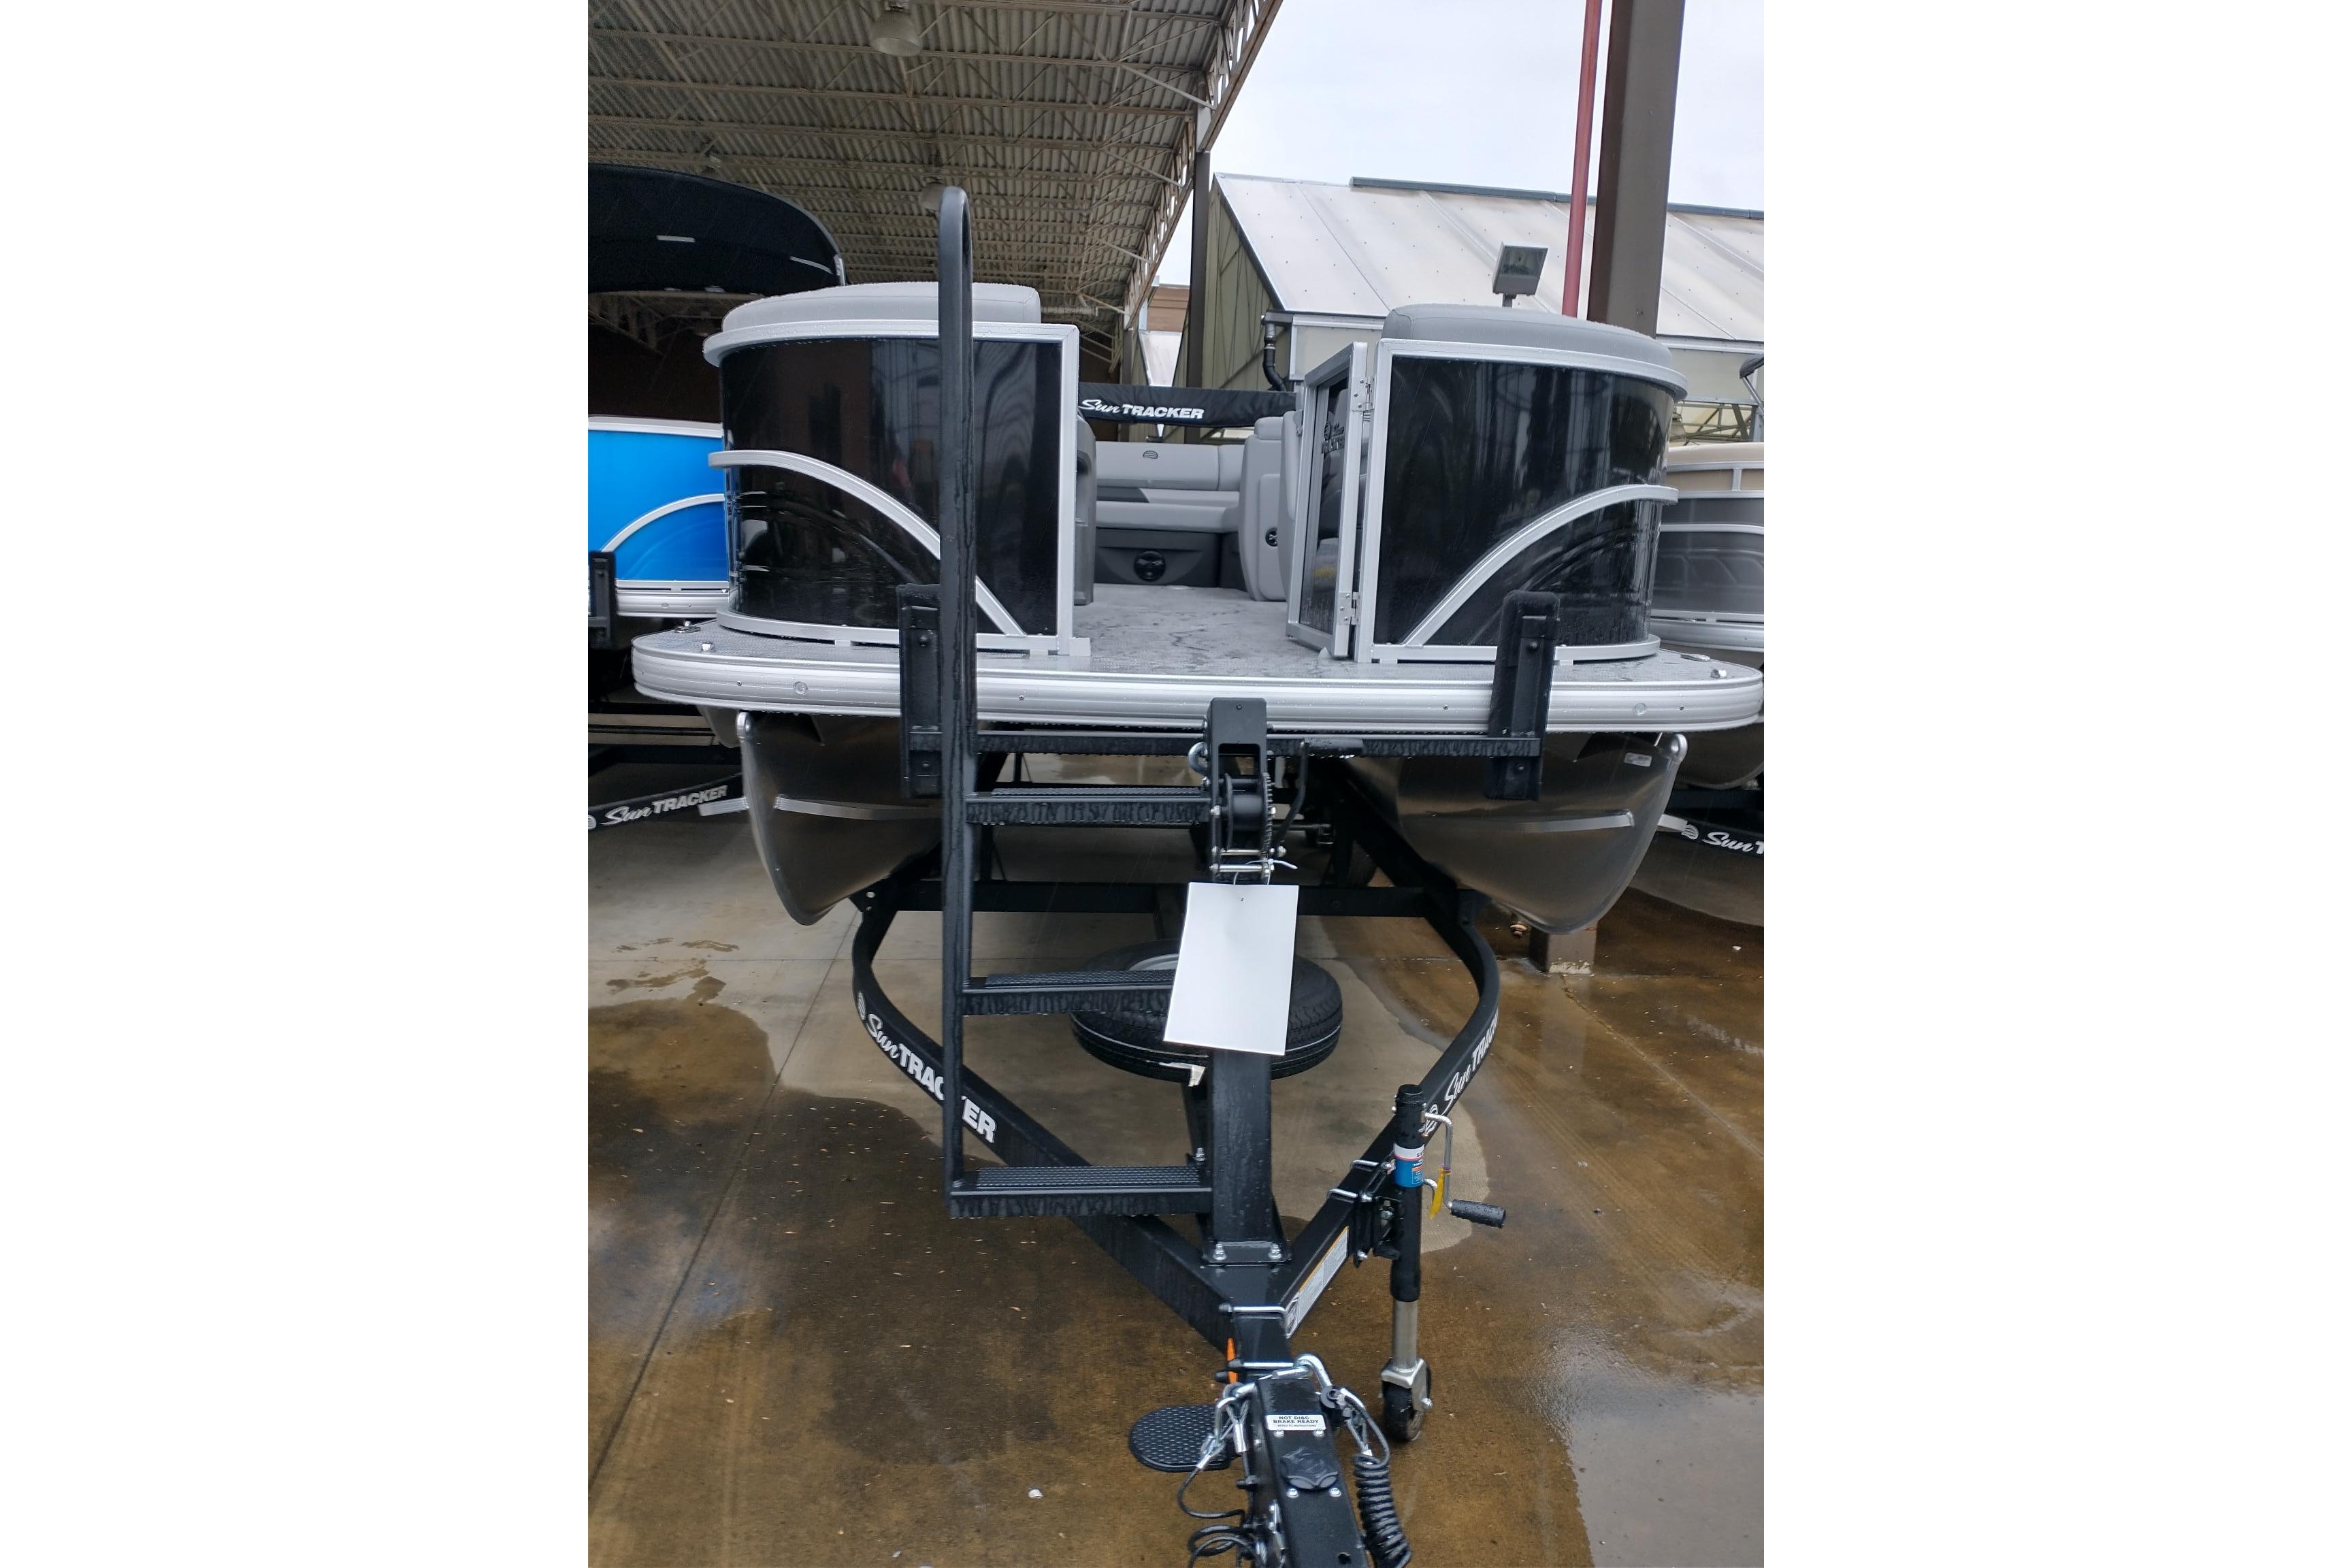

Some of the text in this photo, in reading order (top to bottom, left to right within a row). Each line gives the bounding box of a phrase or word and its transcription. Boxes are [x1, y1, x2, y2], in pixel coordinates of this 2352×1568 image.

[1078, 399, 1204, 420] Sun TRACKER
[598, 785, 728, 826] Sun TRACKER
[1701, 831, 1754, 852] Sun
[866, 1013, 998, 1143] Sun TRACER
